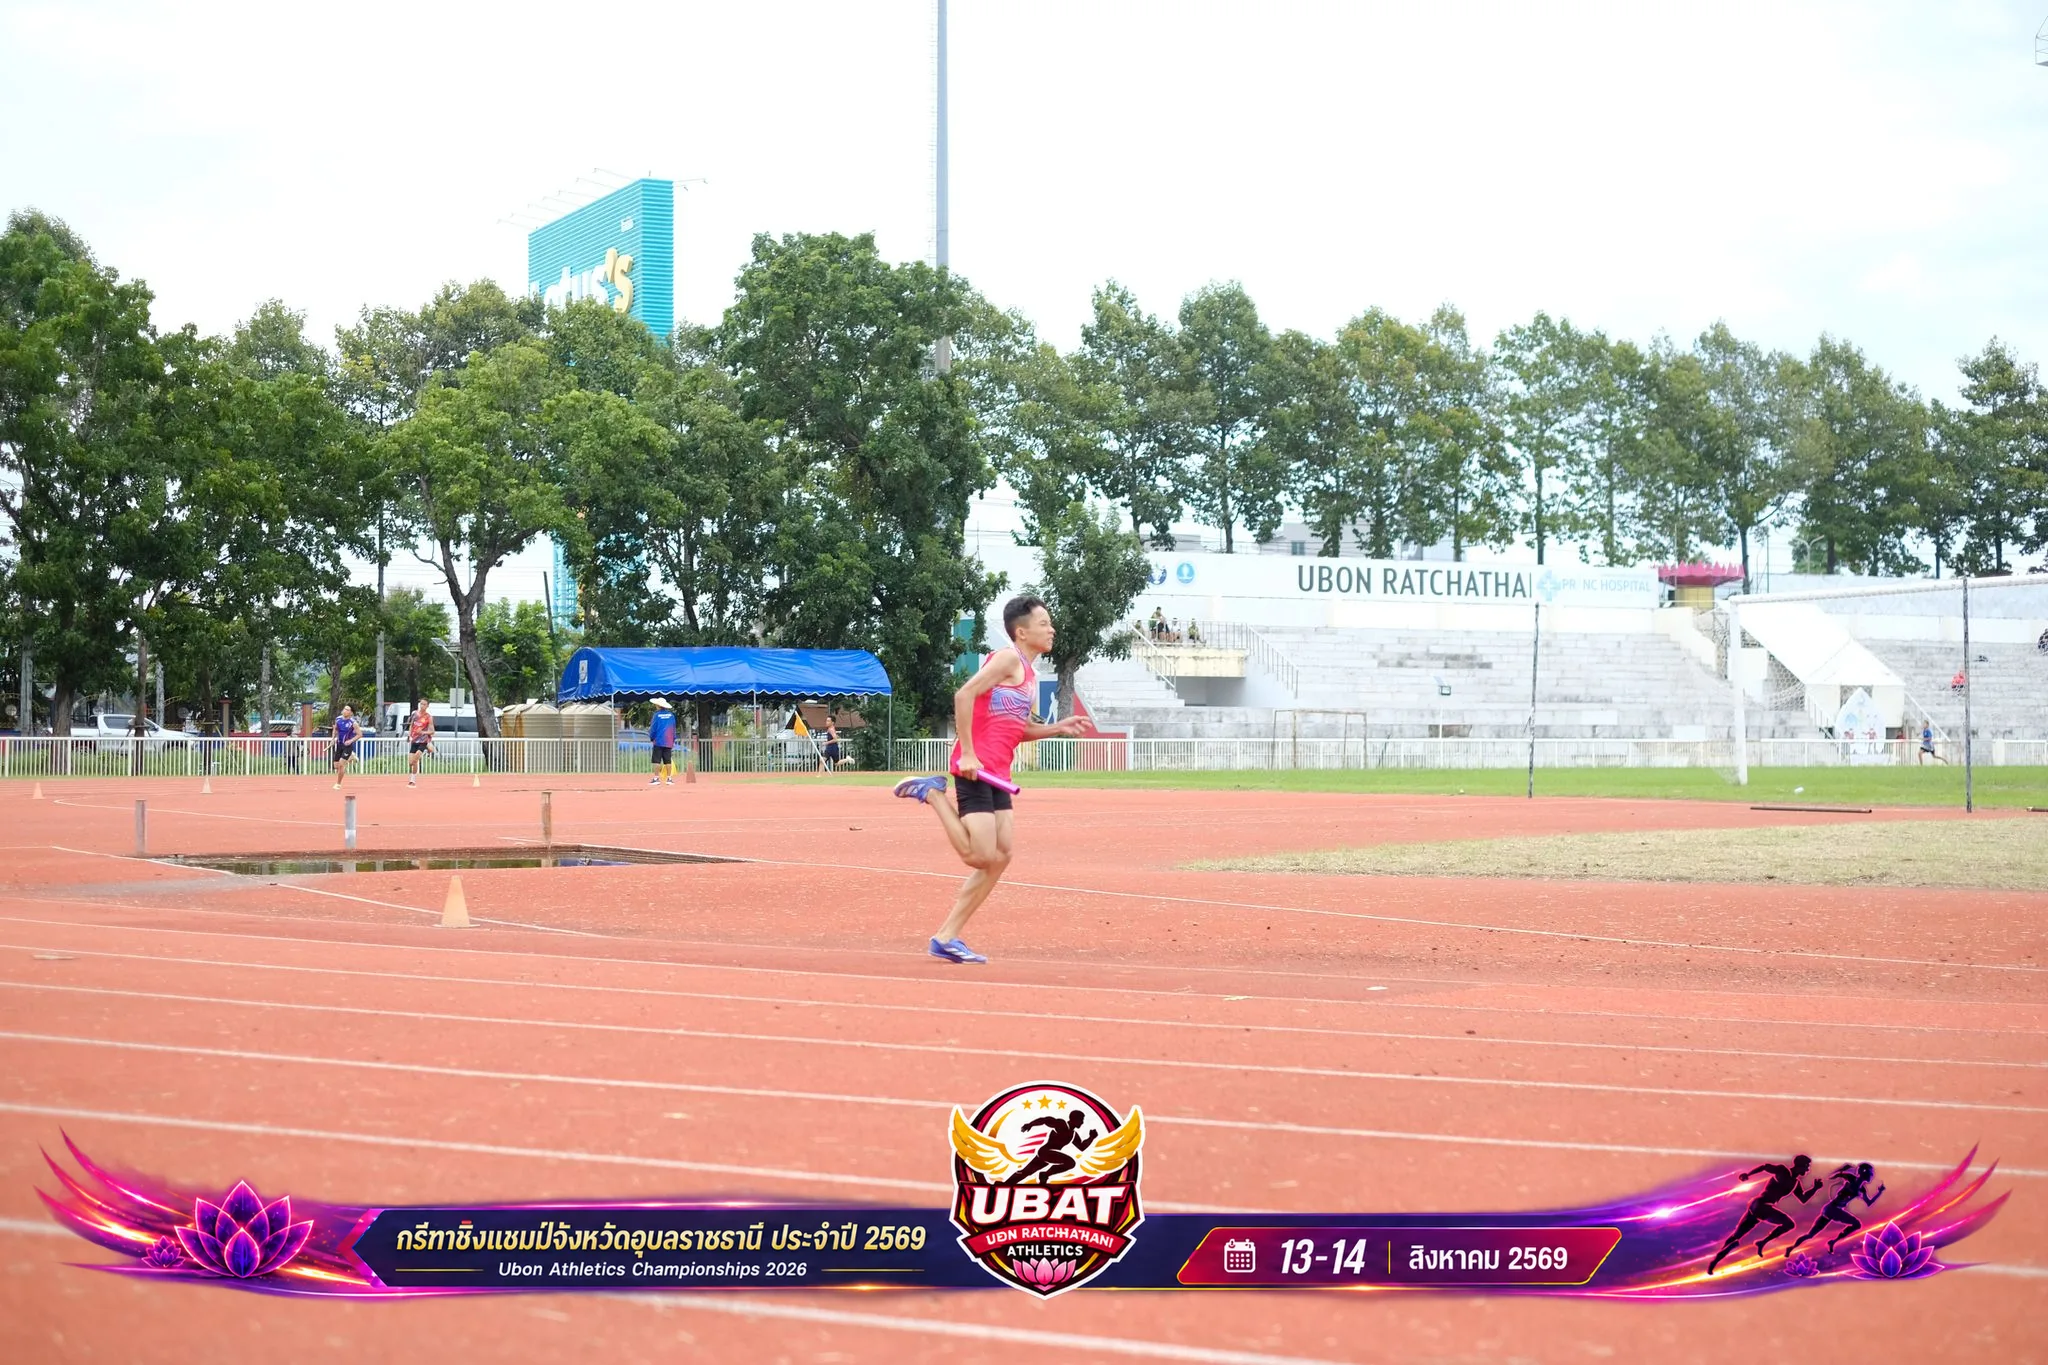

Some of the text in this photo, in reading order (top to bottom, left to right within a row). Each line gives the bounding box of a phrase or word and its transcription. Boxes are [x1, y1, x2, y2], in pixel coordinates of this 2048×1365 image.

[1298, 564, 1532, 599] UBON RATCHATHA
[1601, 579, 1652, 593] HOSPITAL
